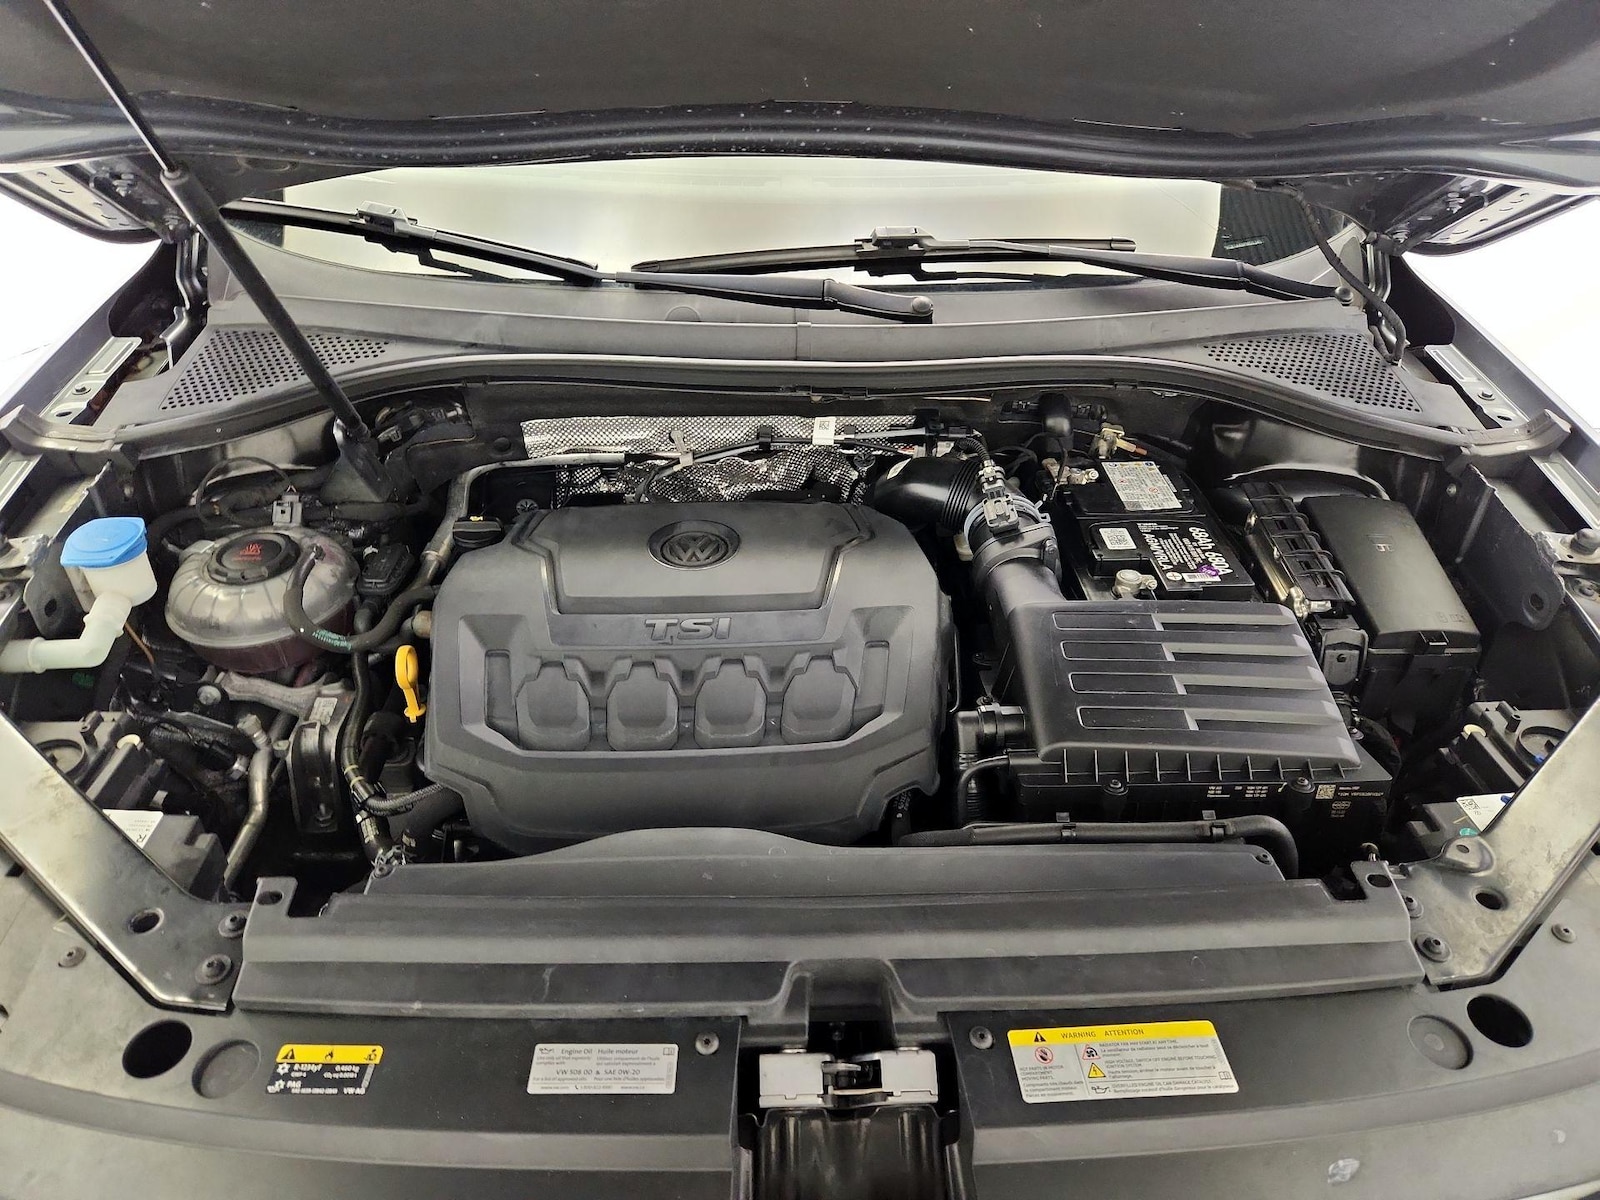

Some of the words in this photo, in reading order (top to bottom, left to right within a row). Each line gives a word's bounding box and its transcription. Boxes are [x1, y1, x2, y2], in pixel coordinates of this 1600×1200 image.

[1189, 527, 1215, 550] 68Ah
[1205, 552, 1233, 575] 680A
[645, 617, 732, 641] TSI
[1060, 1031, 1097, 1039] WARNING
[1104, 1029, 1145, 1037] ATTENTION
[561, 1048, 582, 1056] Engine
